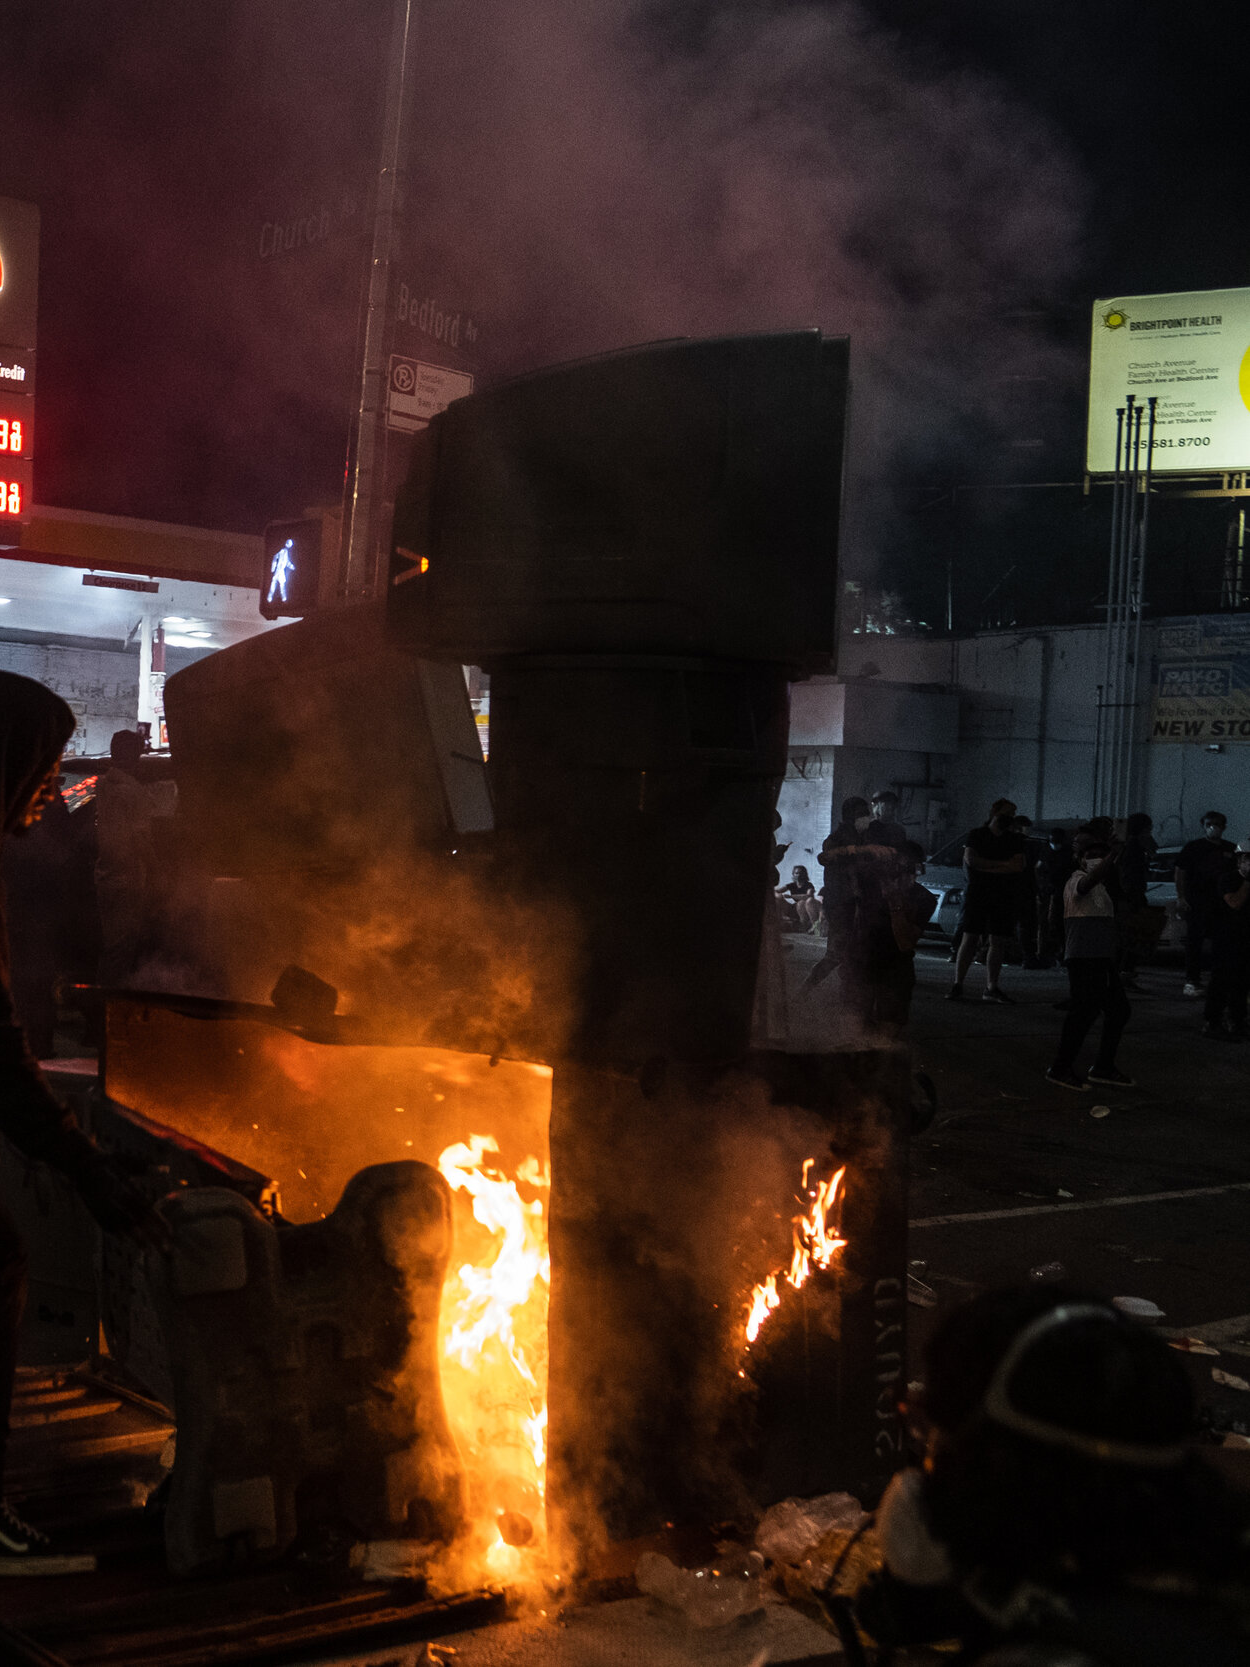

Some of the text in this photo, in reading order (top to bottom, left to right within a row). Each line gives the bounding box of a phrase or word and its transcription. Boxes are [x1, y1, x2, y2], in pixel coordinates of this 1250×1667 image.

[258, 207, 332, 259] Church
[396, 281, 462, 348] Bedford
[1130, 315, 1222, 332] BRIGHTPOINT HEALTH
[1128, 359, 1196, 369] Church Avenue
[1128, 367, 1219, 379] Family Health Center
[1153, 720, 1205, 737] NEW
